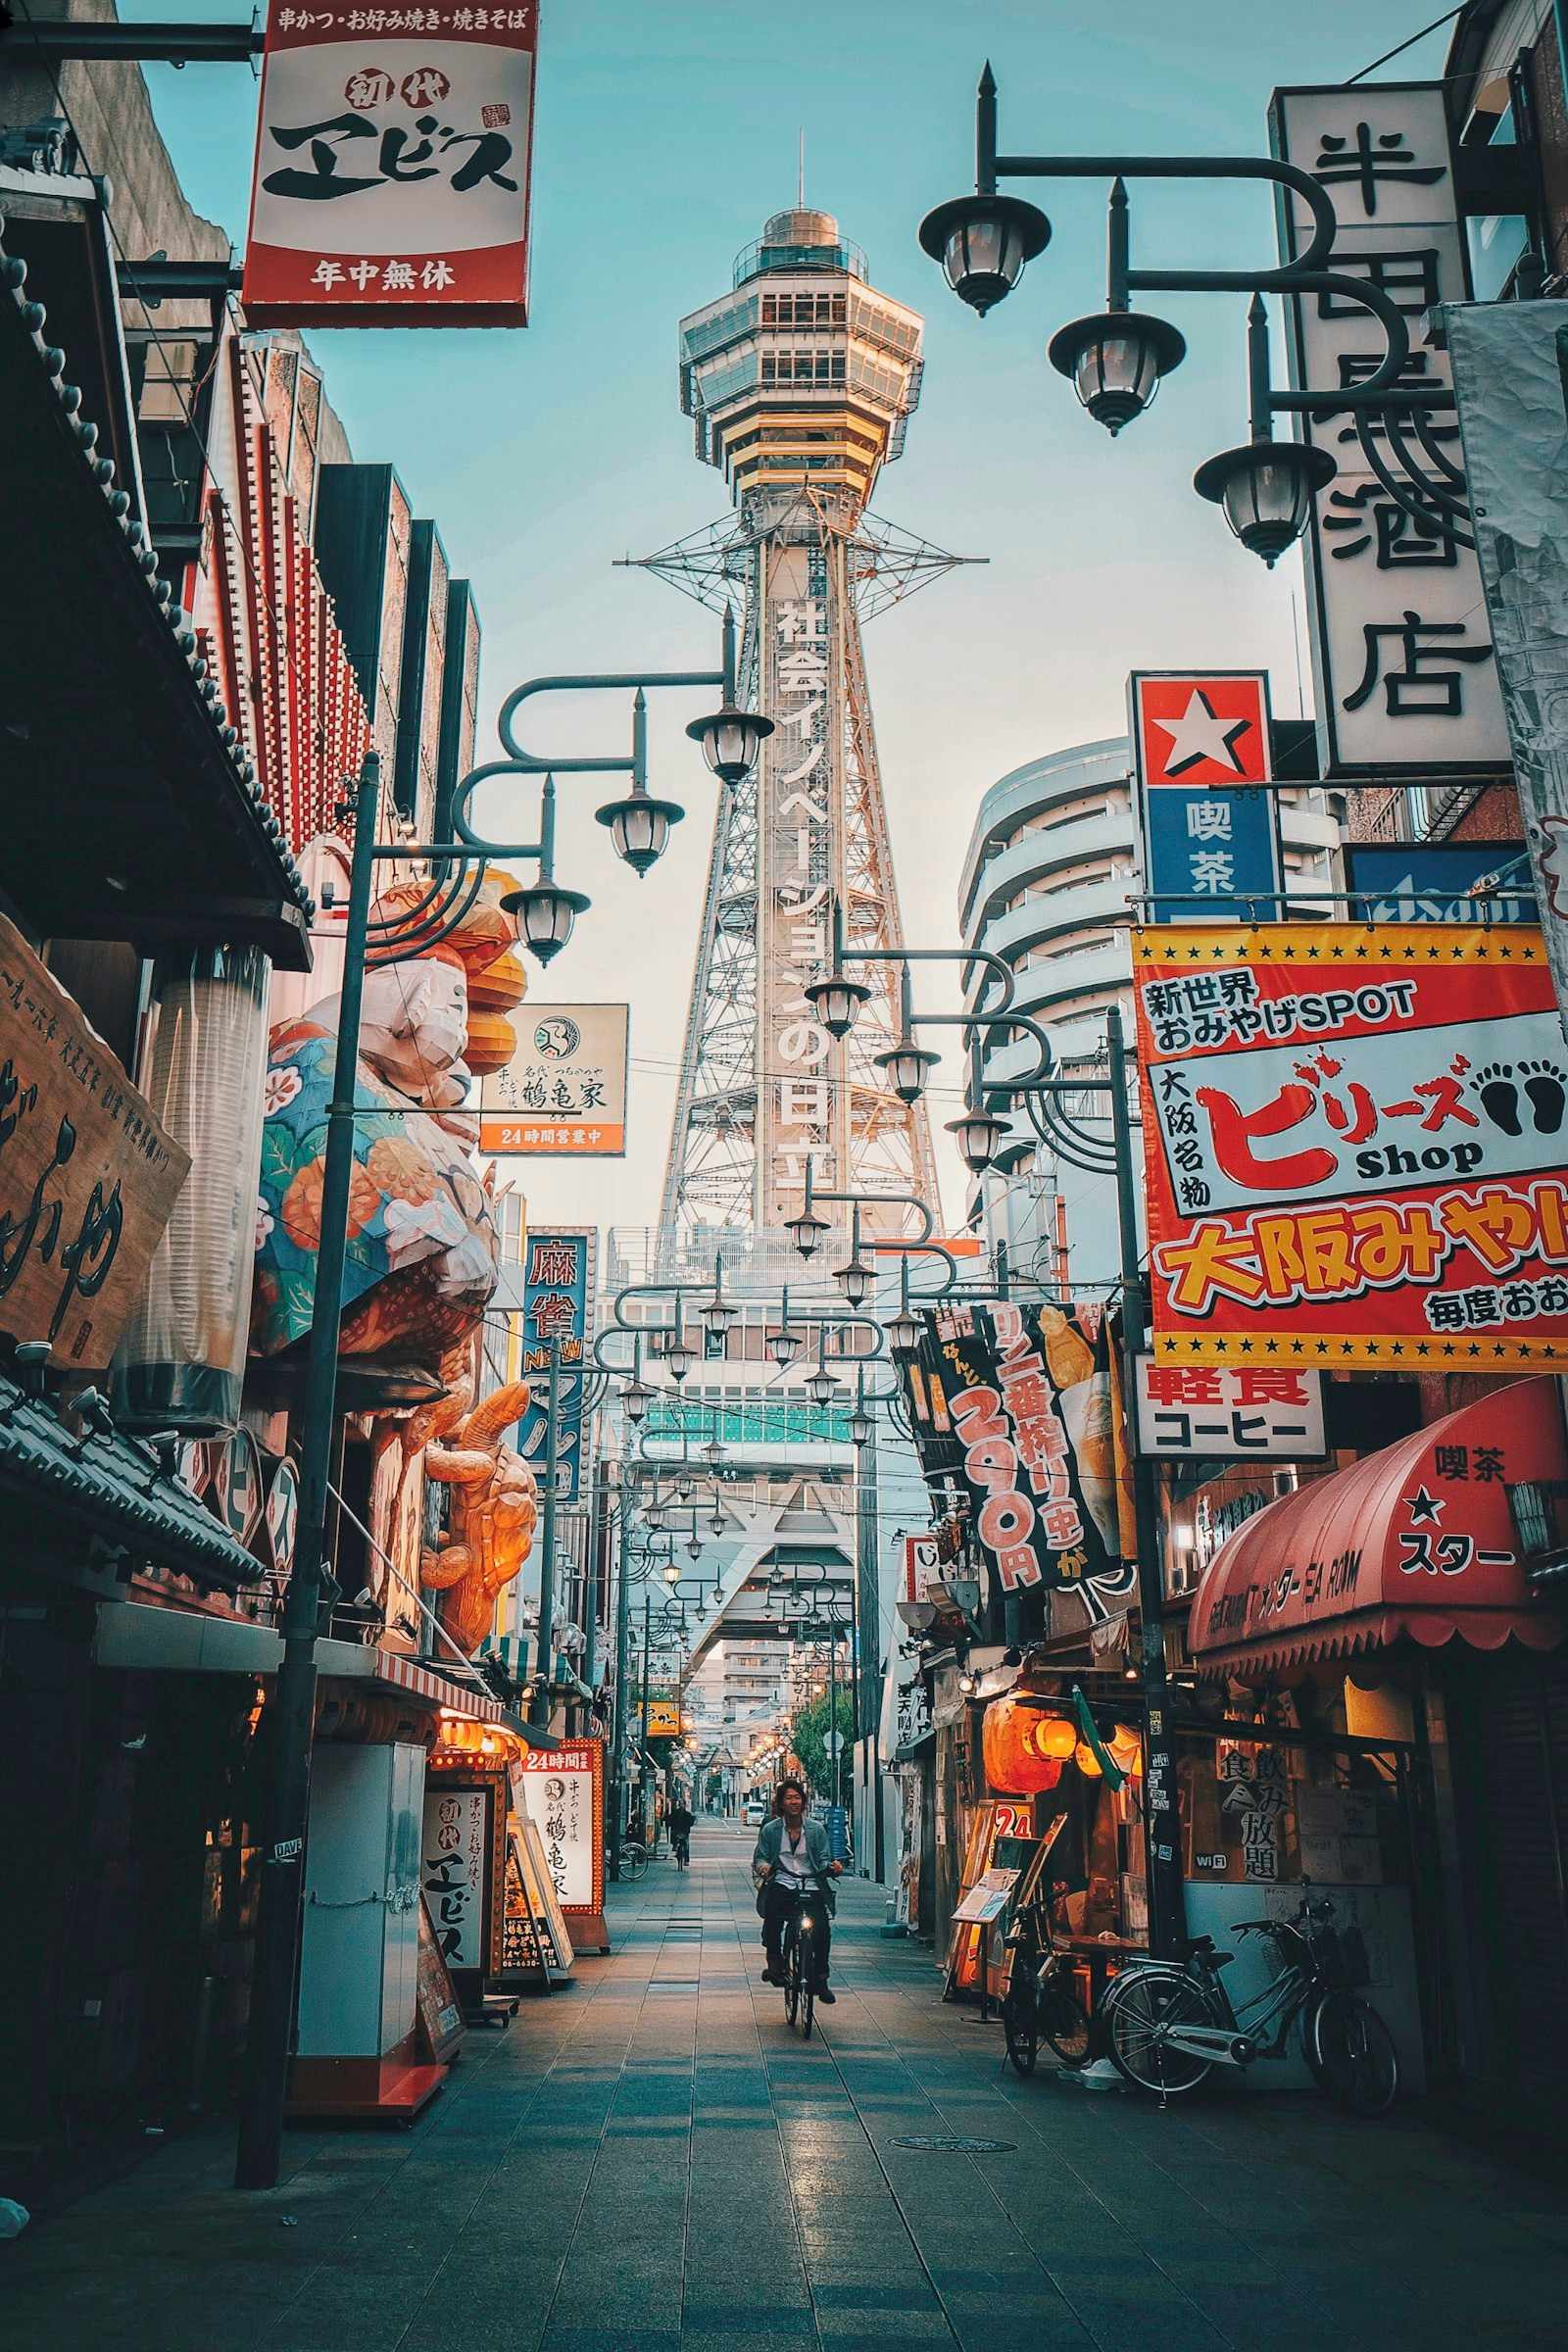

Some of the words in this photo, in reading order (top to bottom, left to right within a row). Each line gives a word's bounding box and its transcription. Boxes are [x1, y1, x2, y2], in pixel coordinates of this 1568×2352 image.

[278, 8, 529, 31] 串かつ・お好み焼き・焼きそば
[349, 70, 447, 109] 初代
[310, 259, 456, 292] 年中無休
[1186, 800, 1236, 893] 喫茶
[1146, 971, 1257, 1019] 新世界
[1154, 983, 1415, 1052] おみやげSPOT
[521, 1077, 608, 1109] 鶴亀家
[501, 1128, 603, 1146] 24時間営業中
[1159, 1069, 1211, 1208] 大阪名物
[527, 1240, 580, 1339] 麻雀
[1427, 1278, 1568, 1327] 毎度おお
[1147, 1368, 1311, 1407] 軽食
[1153, 1410, 1307, 1448] コーヒー
[1435, 1445, 1506, 1483] 喫茶
[948, 1385, 1043, 1592] 290円
[1398, 1533, 1517, 1576] スター
[526, 1751, 579, 1771] 24時間
[275, 1838, 303, 1858] DAVE
[1241, 1811, 1279, 1883] 放題
